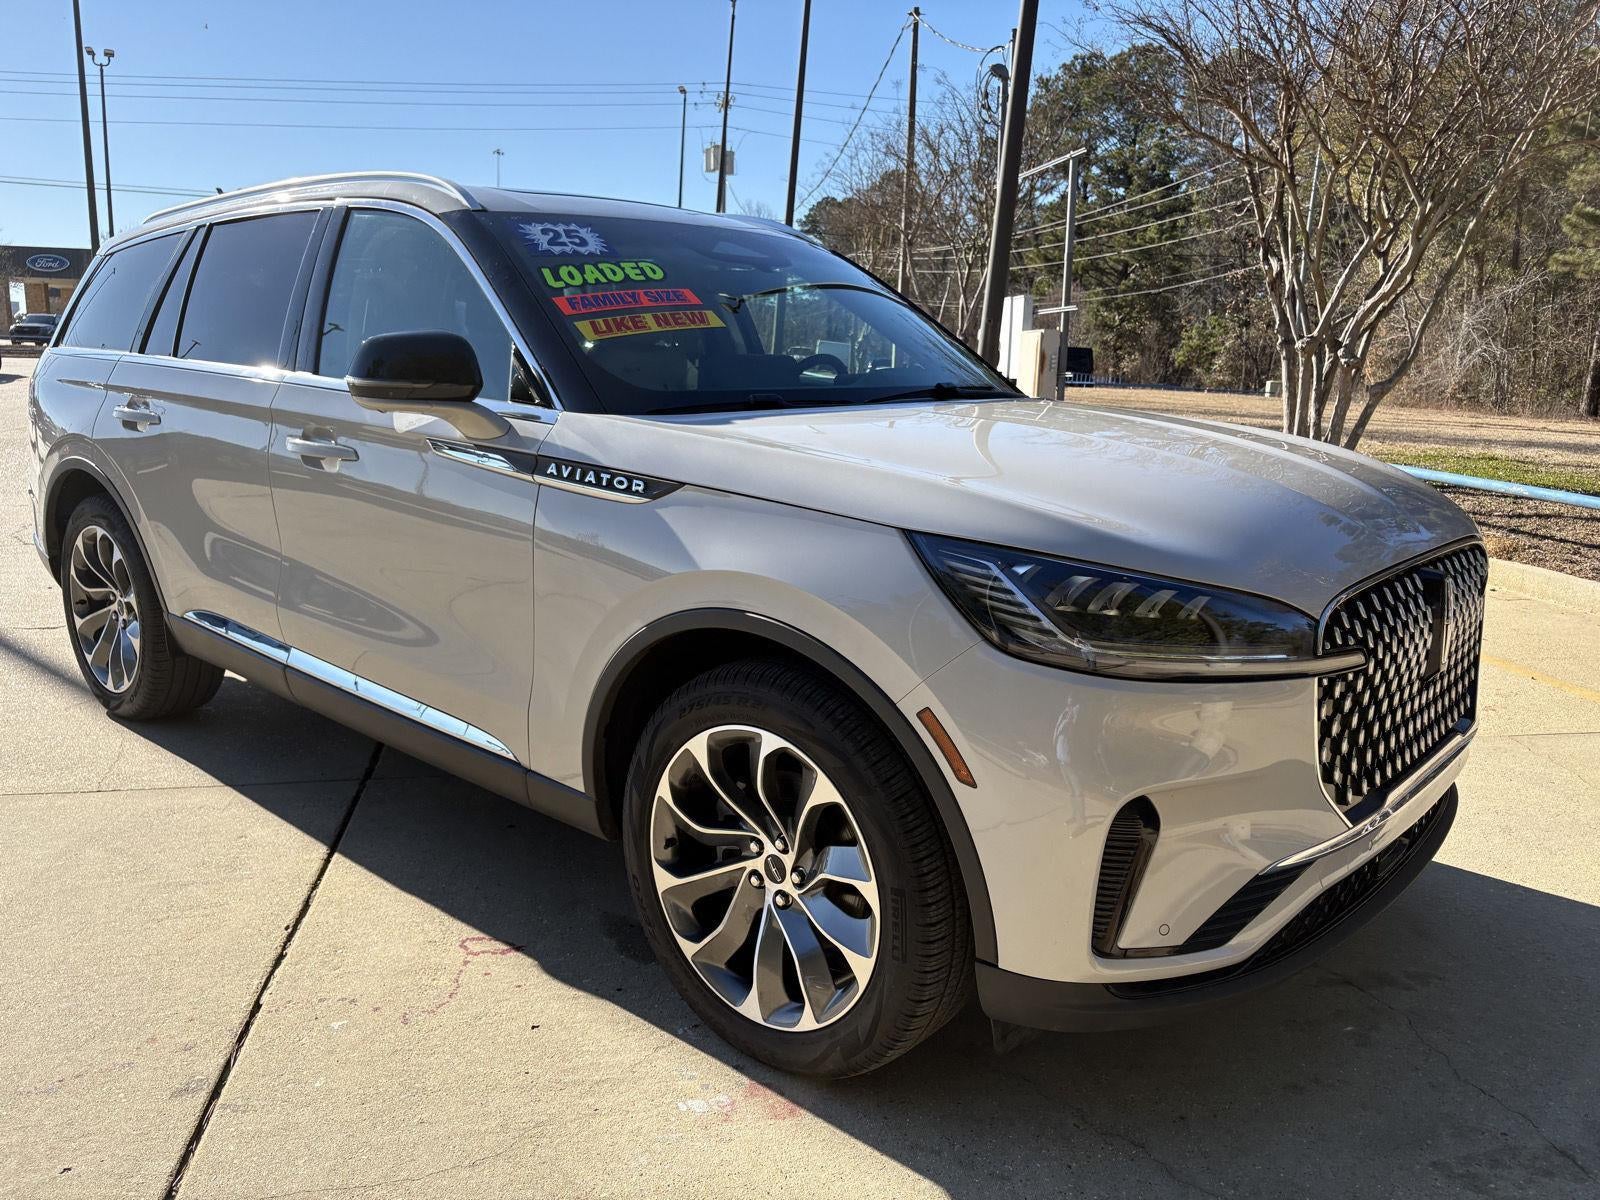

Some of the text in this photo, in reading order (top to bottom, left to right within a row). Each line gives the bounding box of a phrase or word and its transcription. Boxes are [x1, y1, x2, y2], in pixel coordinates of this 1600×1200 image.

[540, 227, 590, 248] 25
[35, 257, 60, 268] Ford
[540, 262, 665, 288] LOADED
[566, 290, 689, 311] FAMILY SIZE
[589, 311, 711, 337] LIKE NEW
[546, 463, 645, 493] AVIATOR
